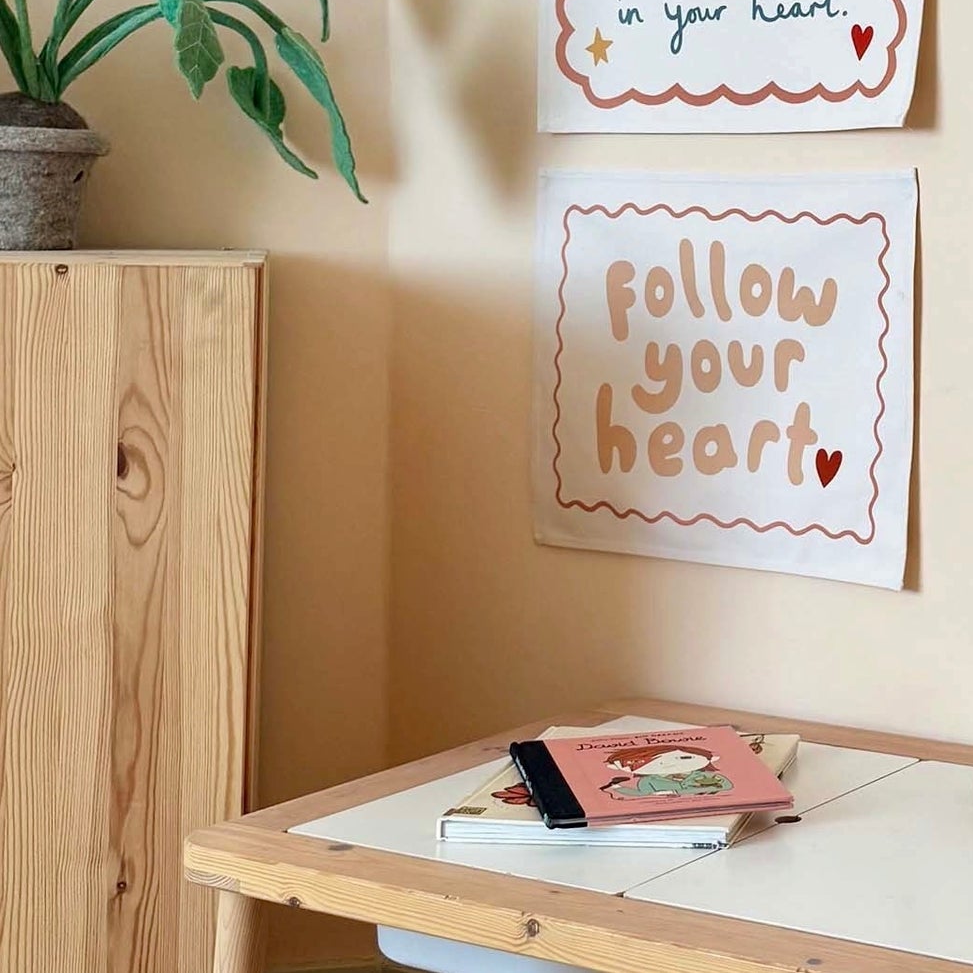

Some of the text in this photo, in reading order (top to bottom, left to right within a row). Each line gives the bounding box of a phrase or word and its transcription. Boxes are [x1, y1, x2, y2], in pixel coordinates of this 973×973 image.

[664, 2, 728, 55] your
[605, 237, 838, 343] follow
[631, 338, 806, 415] your
[595, 382, 819, 486] heart
[576, 740, 639, 751] David
[645, 735, 707, 745] Bowie
